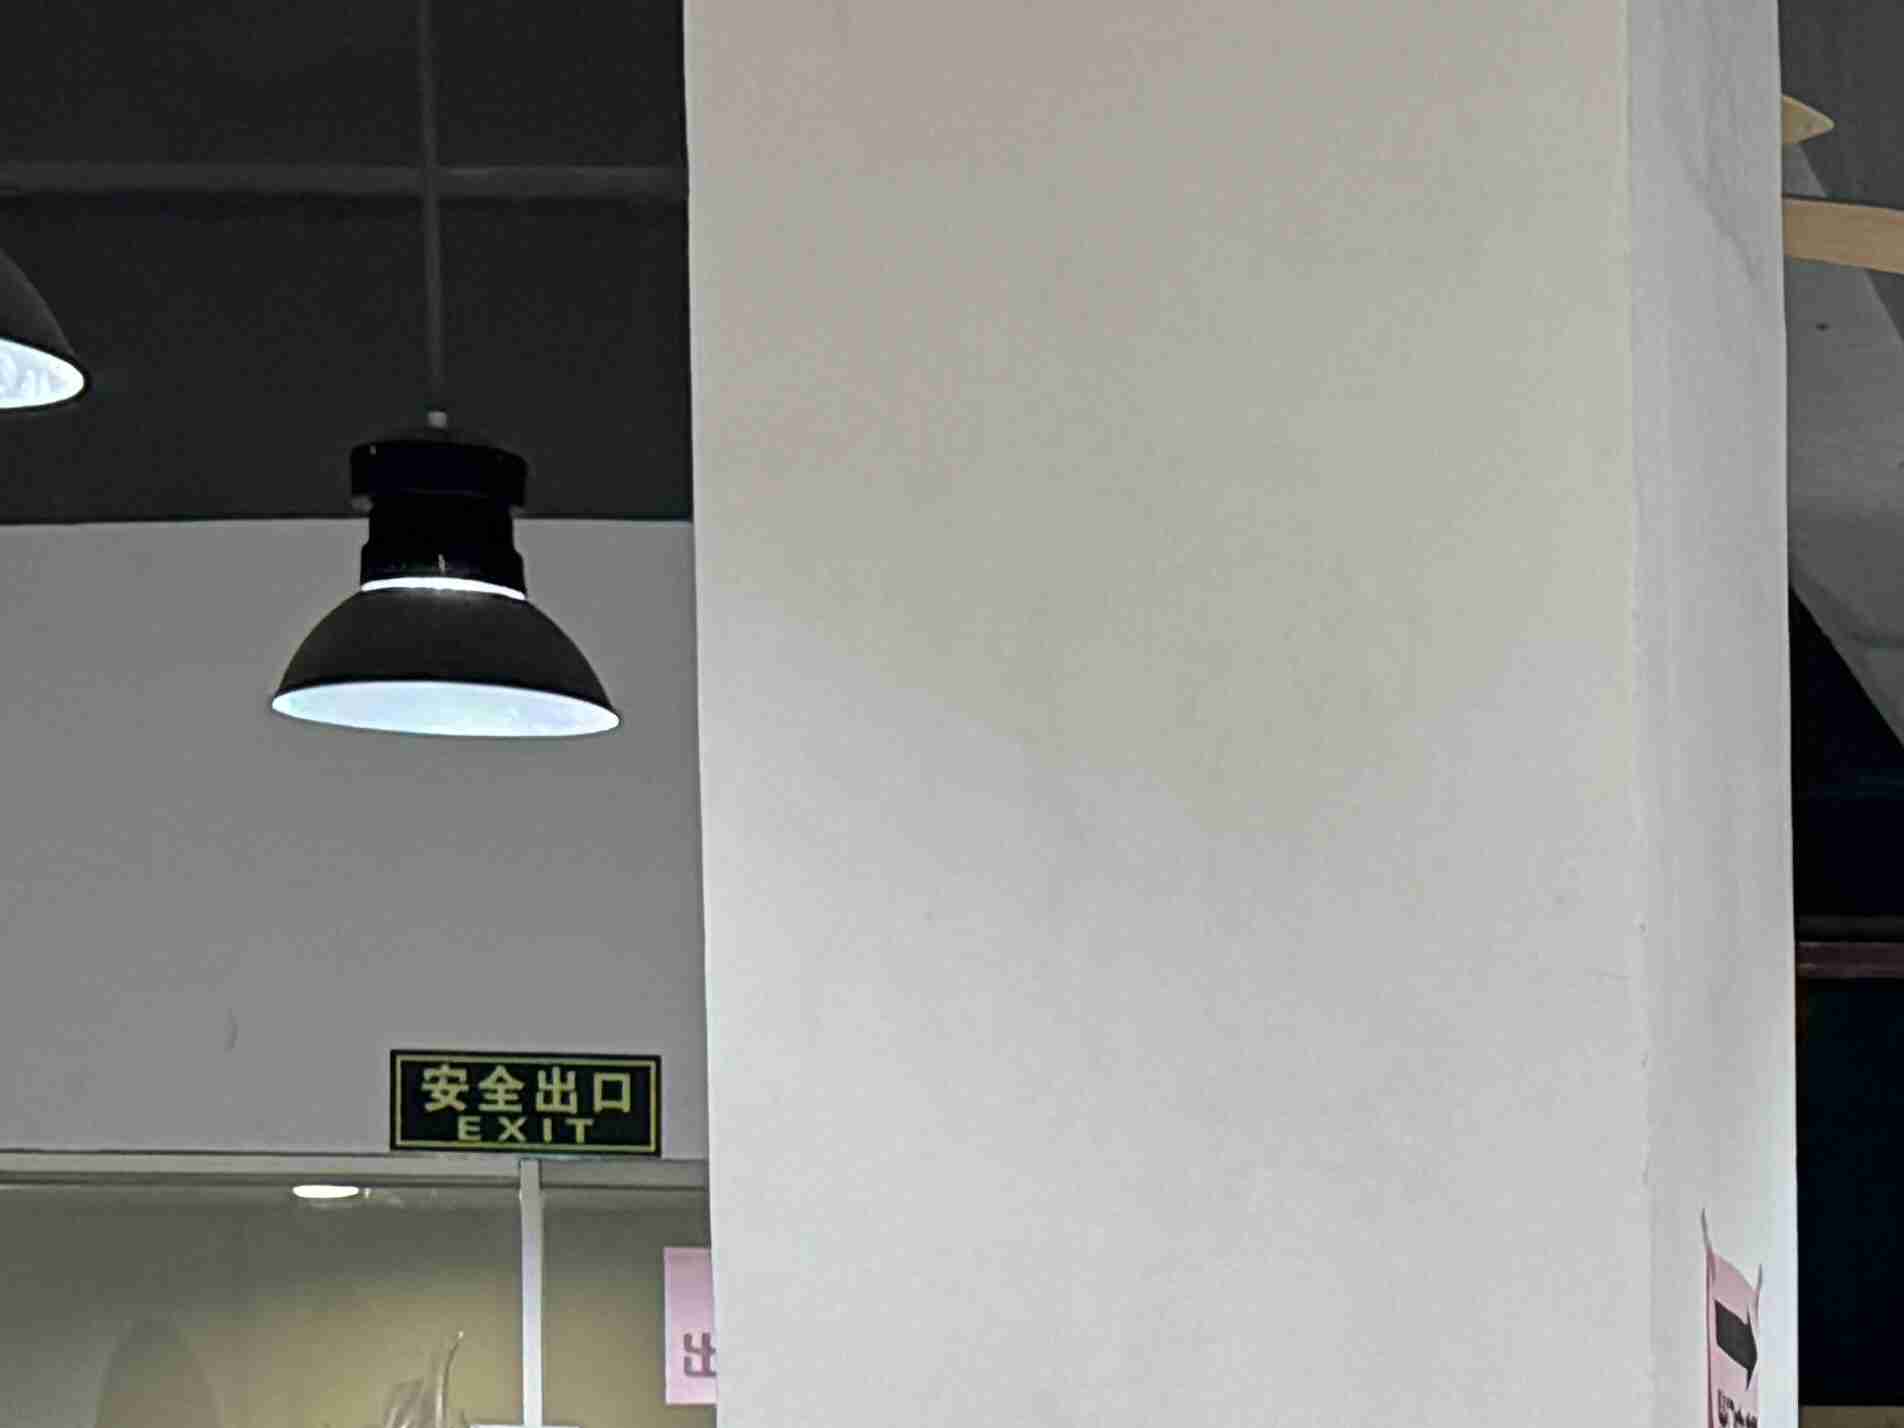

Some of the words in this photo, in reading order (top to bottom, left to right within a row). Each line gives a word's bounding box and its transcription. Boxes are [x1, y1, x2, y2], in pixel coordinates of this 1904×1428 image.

[420, 1064, 632, 1114] 安全出口
[457, 1115, 594, 1144] EXIT
